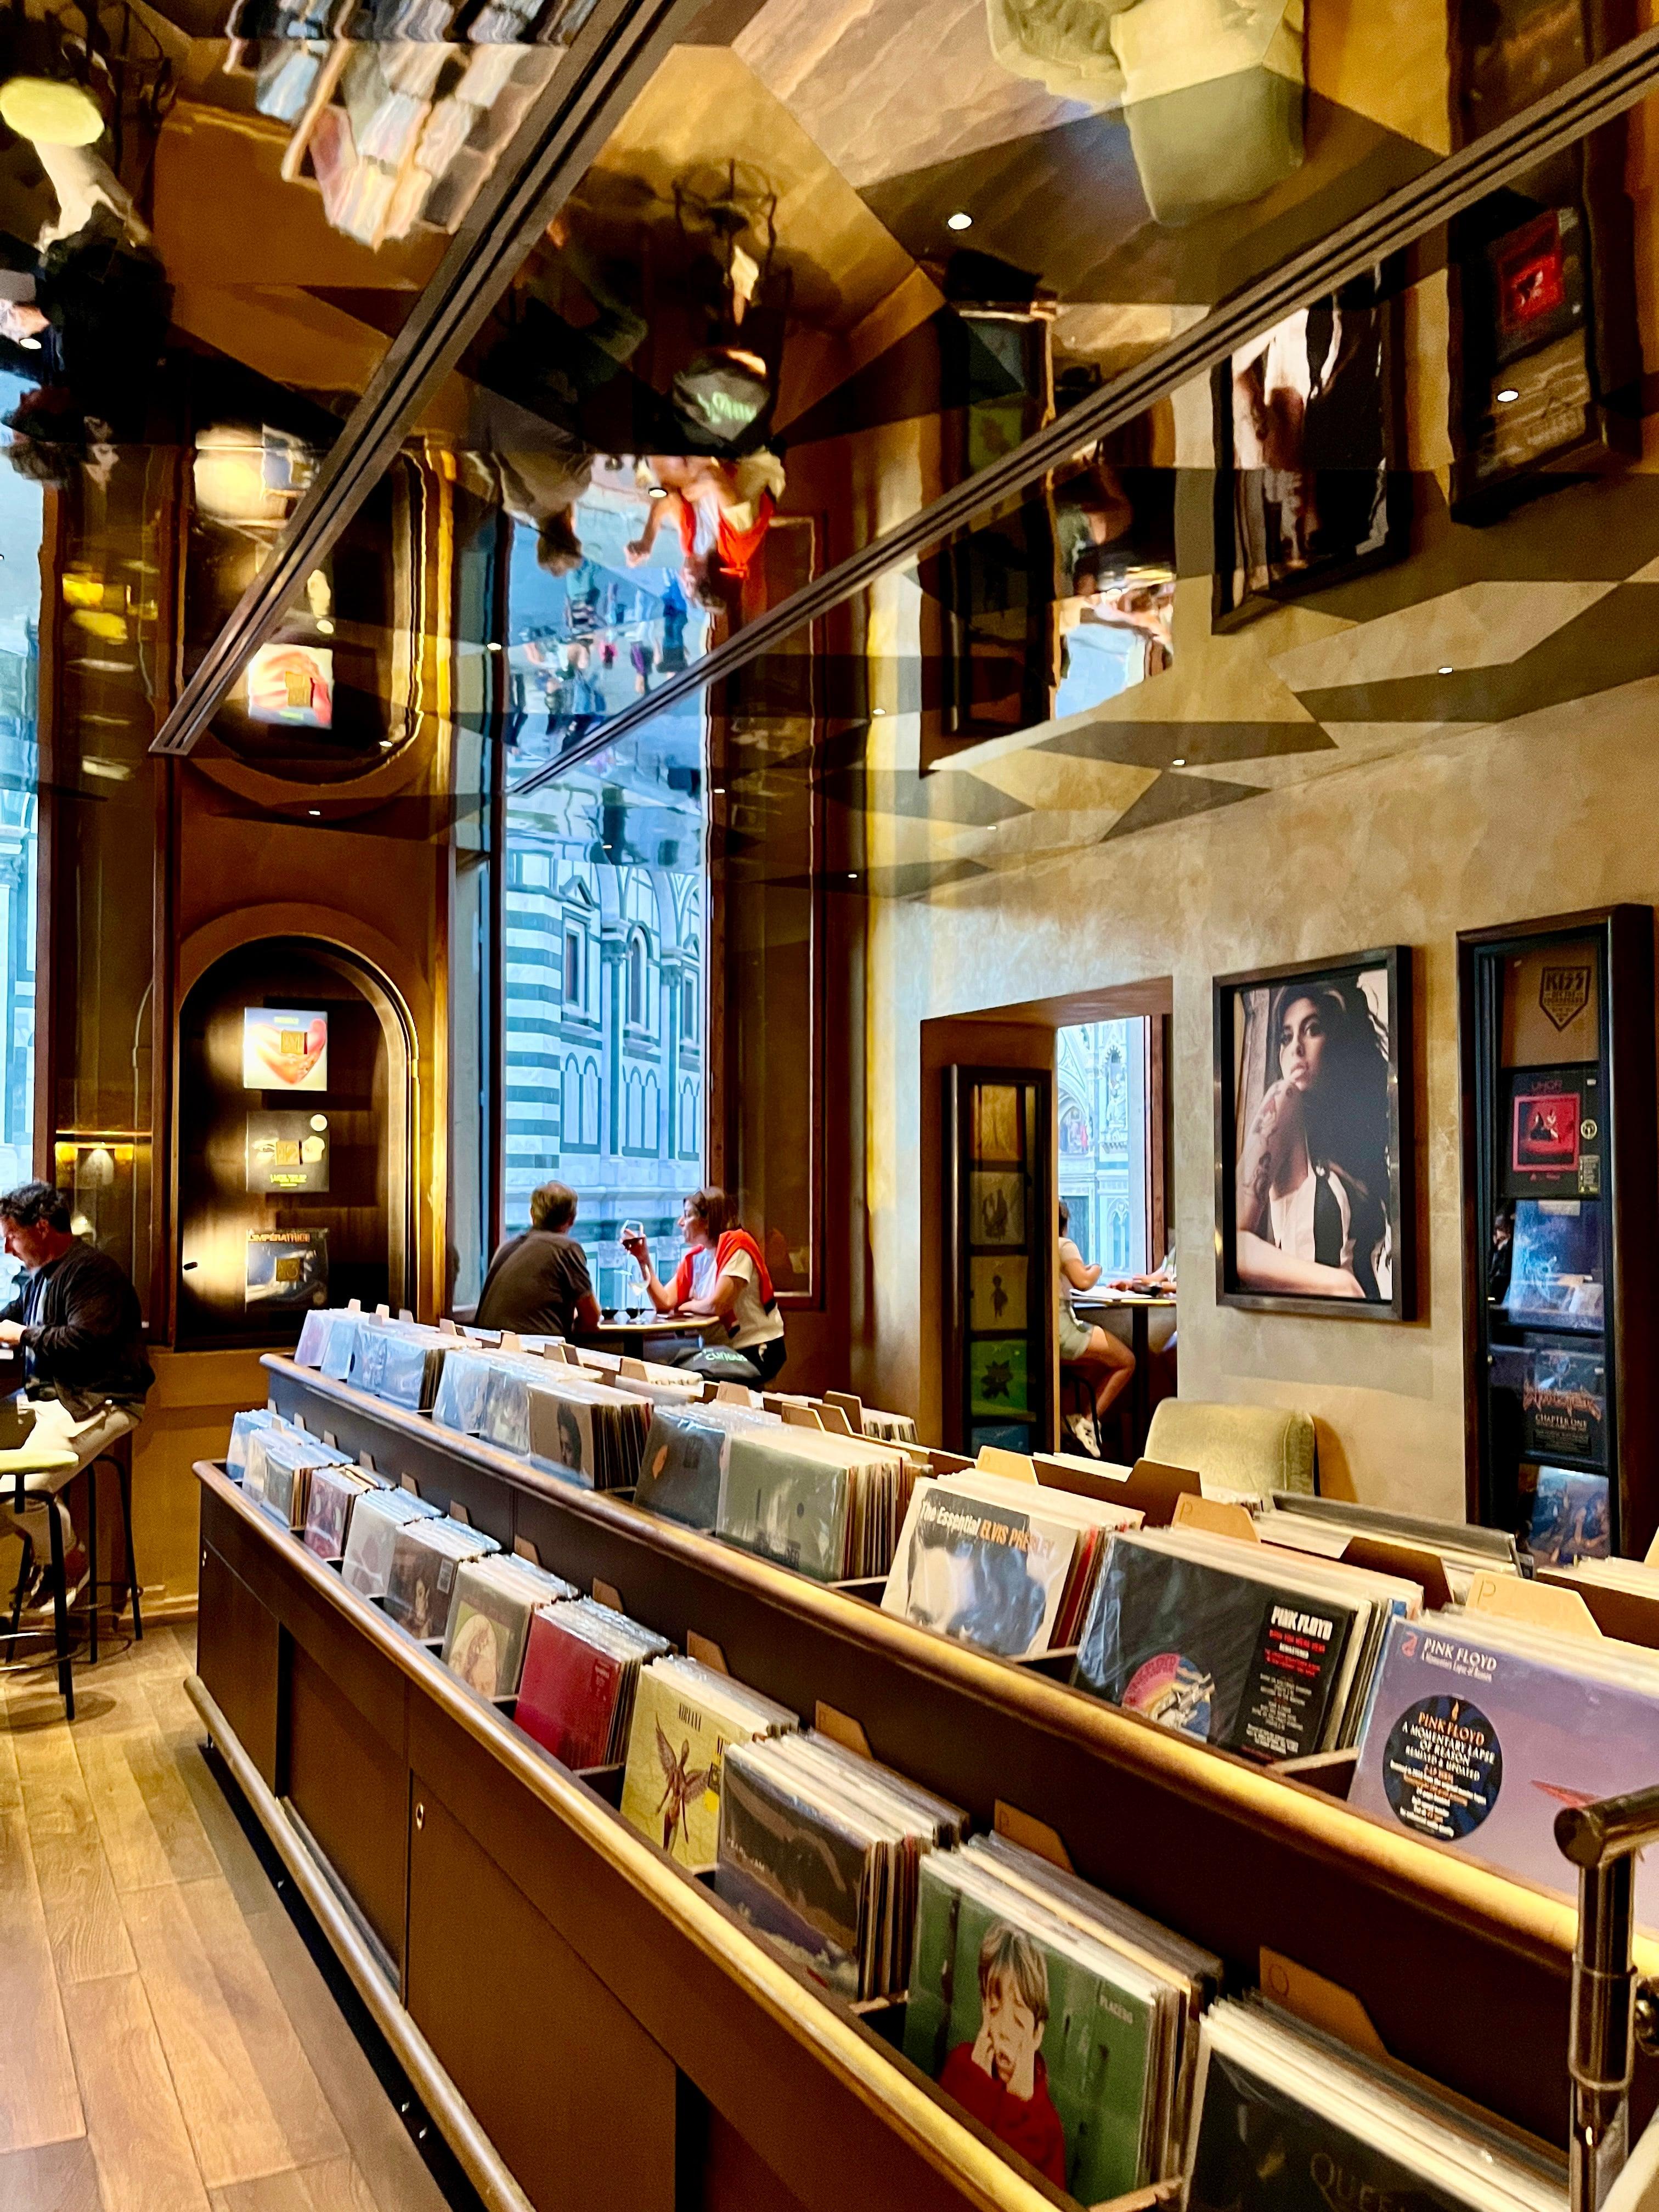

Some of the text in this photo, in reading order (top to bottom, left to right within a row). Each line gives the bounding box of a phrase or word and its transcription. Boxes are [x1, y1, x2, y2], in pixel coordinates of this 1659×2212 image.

[1545, 972, 1584, 991] KISS
[920, 1500, 937, 1521] The
[936, 1506, 981, 1536] Essential
[980, 1519, 1009, 1545] ELVIS
[1476, 1577, 1496, 1607] P
[1271, 1605, 1333, 1641] PINK FLOYD
[1424, 1637, 1497, 1671] PINK FLOYD
[1402, 1721, 1496, 1765] A MOMENTARY LAPSE
[1418, 1711, 1485, 1747] PINK FLOYD
[1420, 1740, 1471, 1767] OF REASON
